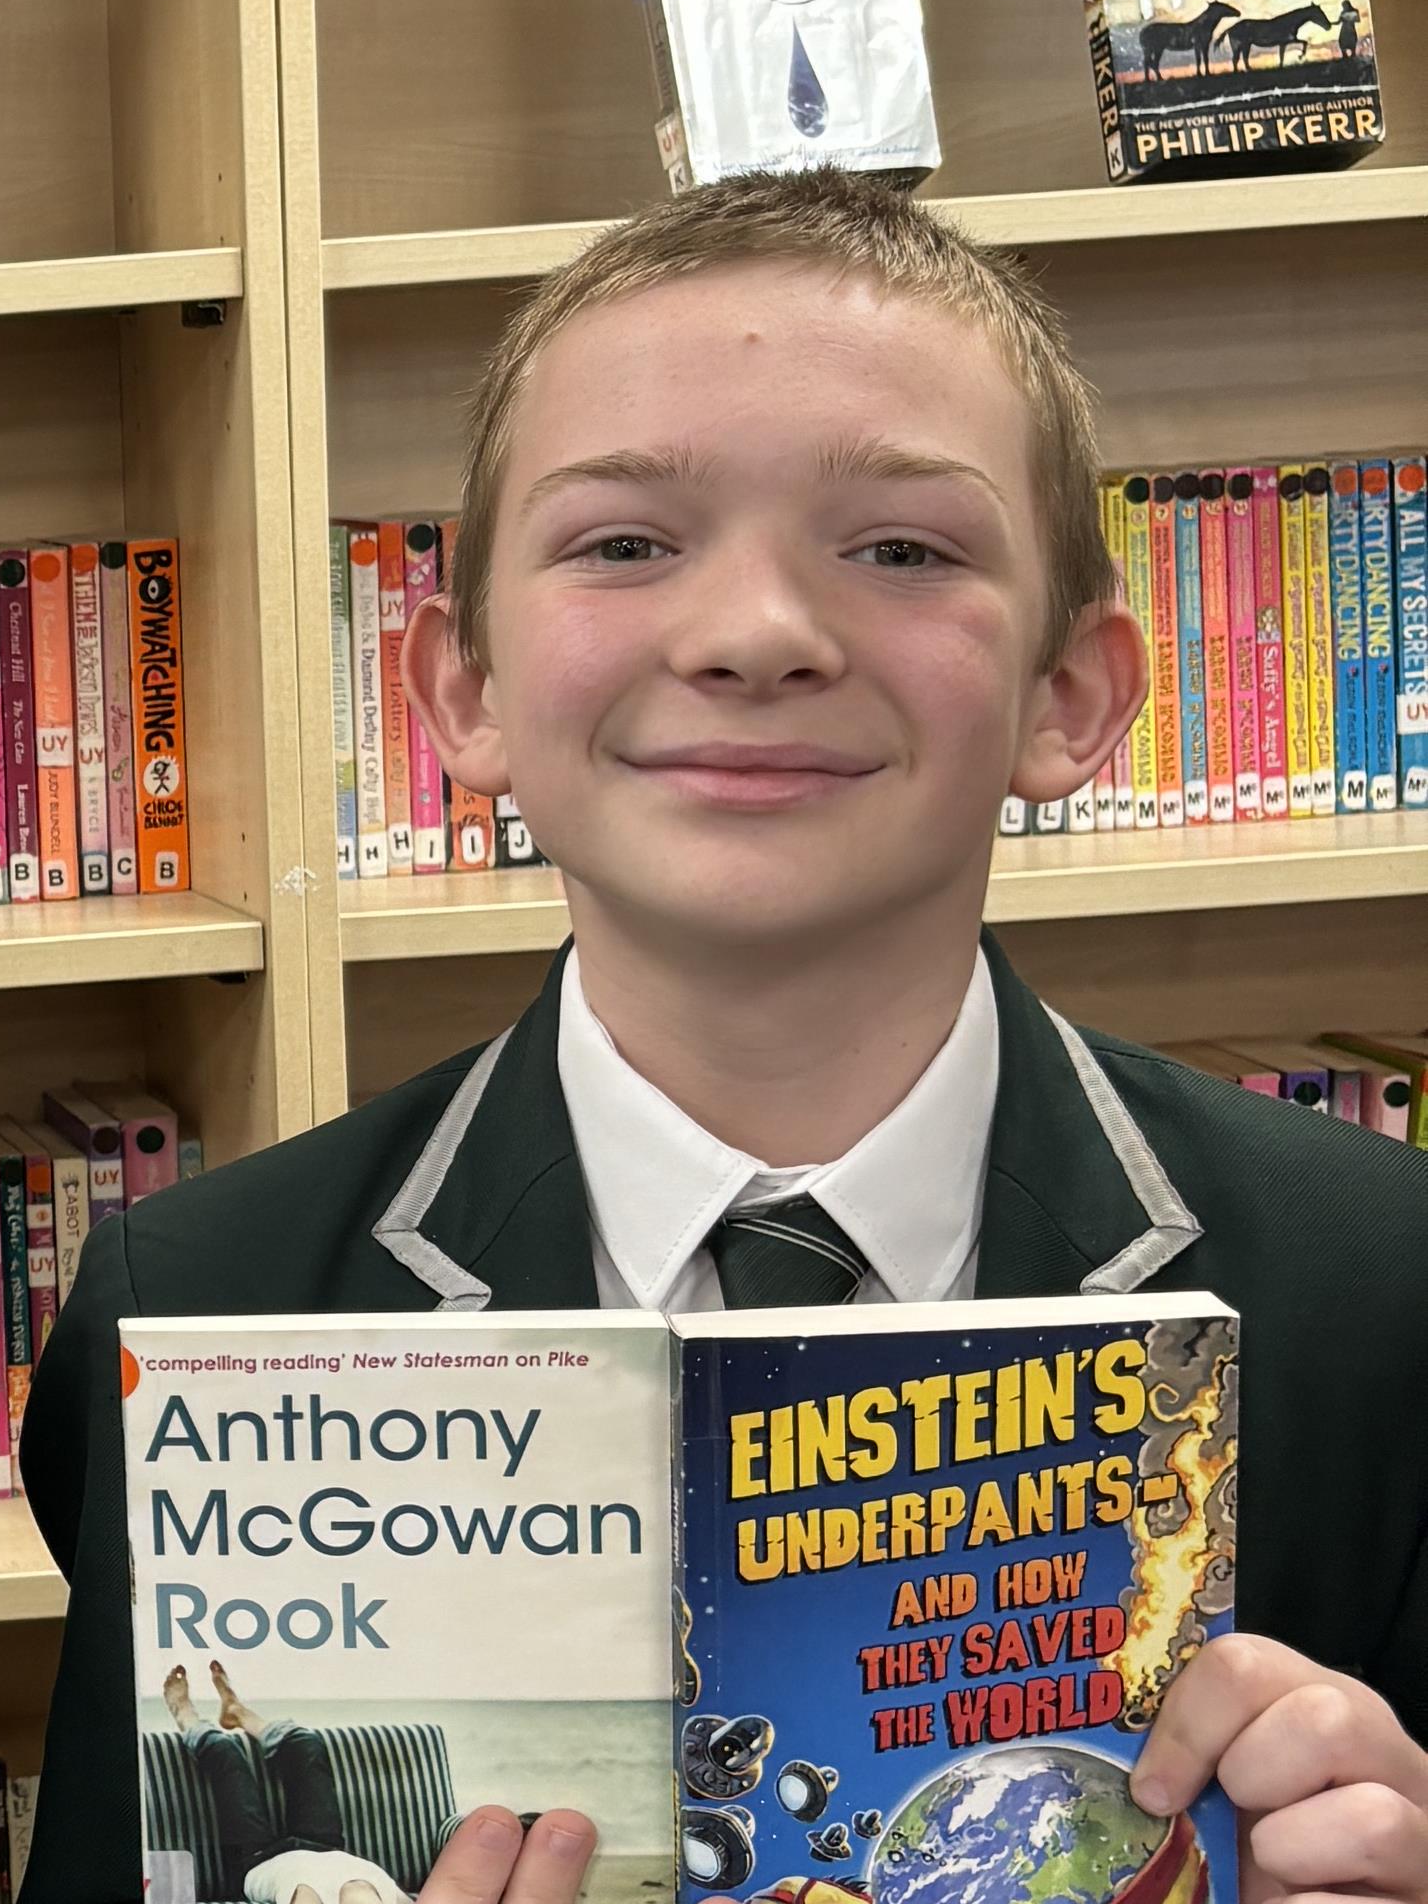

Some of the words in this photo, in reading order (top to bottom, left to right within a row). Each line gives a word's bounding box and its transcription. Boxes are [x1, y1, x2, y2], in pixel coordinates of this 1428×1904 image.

[1135, 122, 1156, 133] THE
[1160, 119, 1184, 130] NEW
[1187, 116, 1215, 127] YORK
[1218, 111, 1251, 123] TIMES
[1252, 103, 1324, 118] BESTSELLING
[1327, 97, 1373, 110] AUTHOR
[1137, 122, 1263, 164] PHILIP
[1277, 109, 1379, 148] KERR
[1400, 509, 1425, 551] ALL
[1337, 556, 1359, 660] DANCING
[1367, 553, 1392, 658] DANCING
[135, 550, 177, 751] BOYWATCHING
[1403, 596, 1427, 696] SECRETS
[1265, 717, 1280, 769] Angel
[89, 865, 103, 882] B
[141, 1355, 257, 1374] 'compelling
[262, 1352, 345, 1372] reading'
[352, 1352, 397, 1368] New
[403, 1351, 509, 1368] Statesman
[515, 1353, 541, 1367] on
[548, 1351, 589, 1367] Pike
[145, 1393, 541, 1477] Anthony
[729, 1337, 1147, 1501] EINSTEIN'S
[152, 1487, 641, 1557] McGowan
[156, 1582, 389, 1651] Rook
[893, 1573, 978, 1626] AND
[998, 1553, 1087, 1609] HOW
[859, 1634, 955, 1694] THEY
[964, 1606, 1128, 1679] SAVED
[874, 1701, 938, 1752] THE
[943, 1670, 1125, 1750] WORLD
